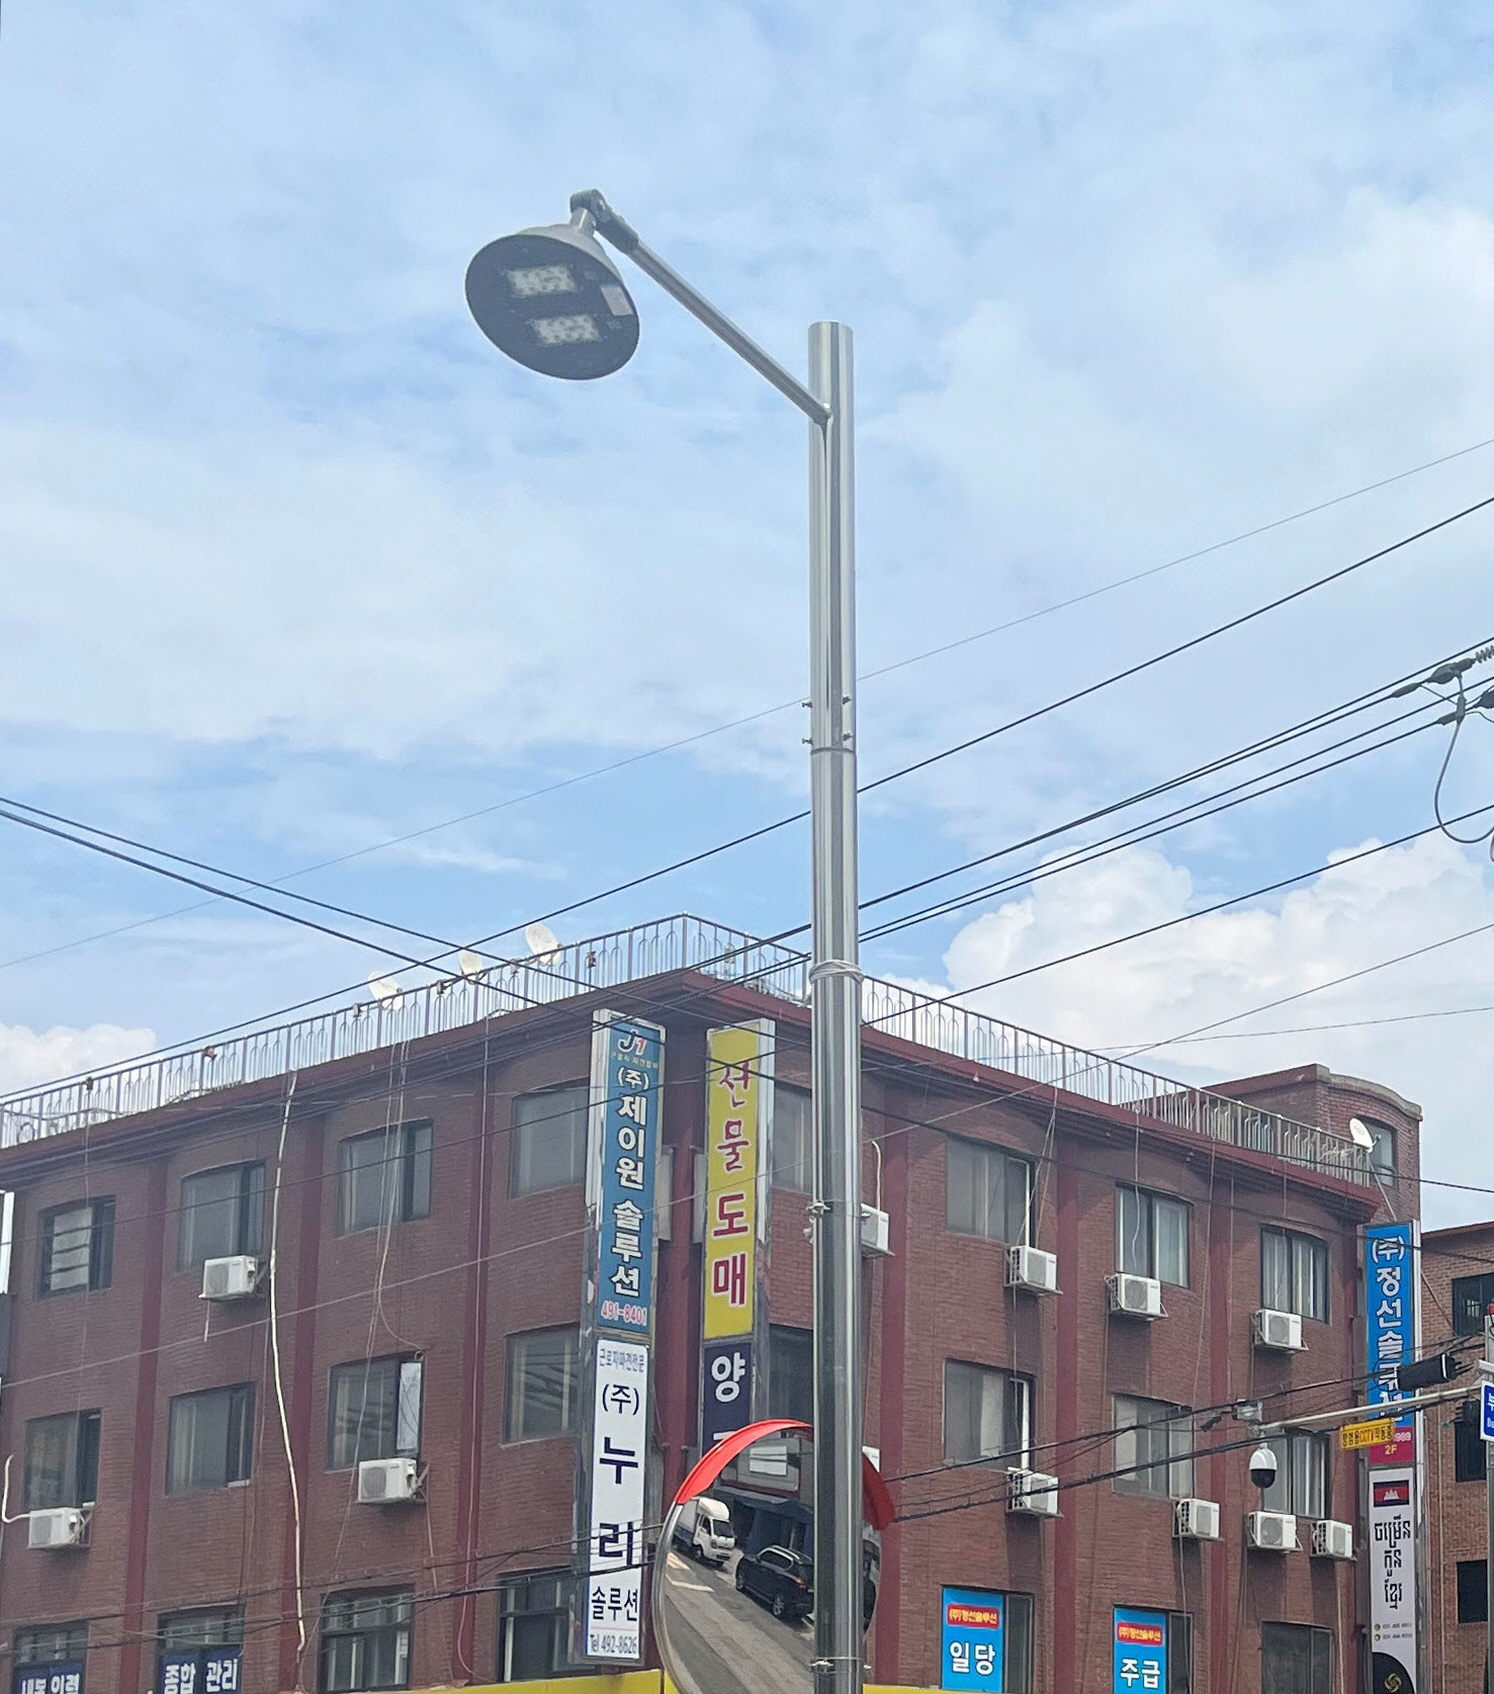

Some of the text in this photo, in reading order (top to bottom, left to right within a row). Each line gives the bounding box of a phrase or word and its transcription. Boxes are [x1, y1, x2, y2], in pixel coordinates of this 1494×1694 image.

[601, 1301, 648, 1327] 491-8401
[591, 1586, 638, 1622] 솔루션
[949, 1641, 996, 1675] 일당
[1119, 1657, 1161, 1690] 주급
[206, 1658, 239, 1694] 관리
